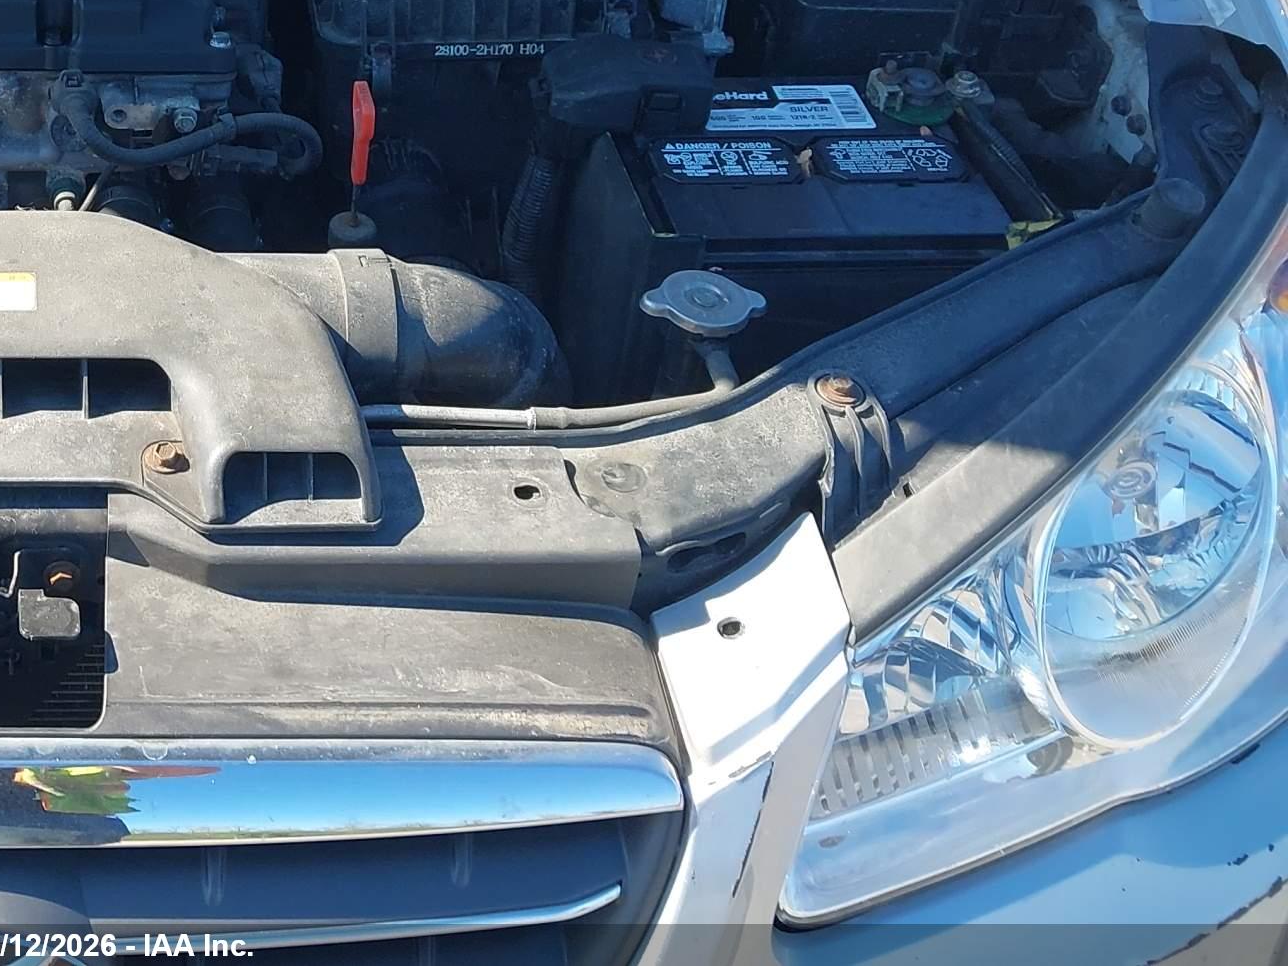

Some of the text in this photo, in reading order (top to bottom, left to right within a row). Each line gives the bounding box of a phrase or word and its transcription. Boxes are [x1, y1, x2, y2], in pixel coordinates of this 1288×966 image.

[434, 44, 545, 56] 28100-2H170 H04
[712, 91, 769, 101] eHard
[790, 105, 828, 113] SILVER
[675, 142, 720, 150] DANGER
[730, 141, 772, 149] POISON
